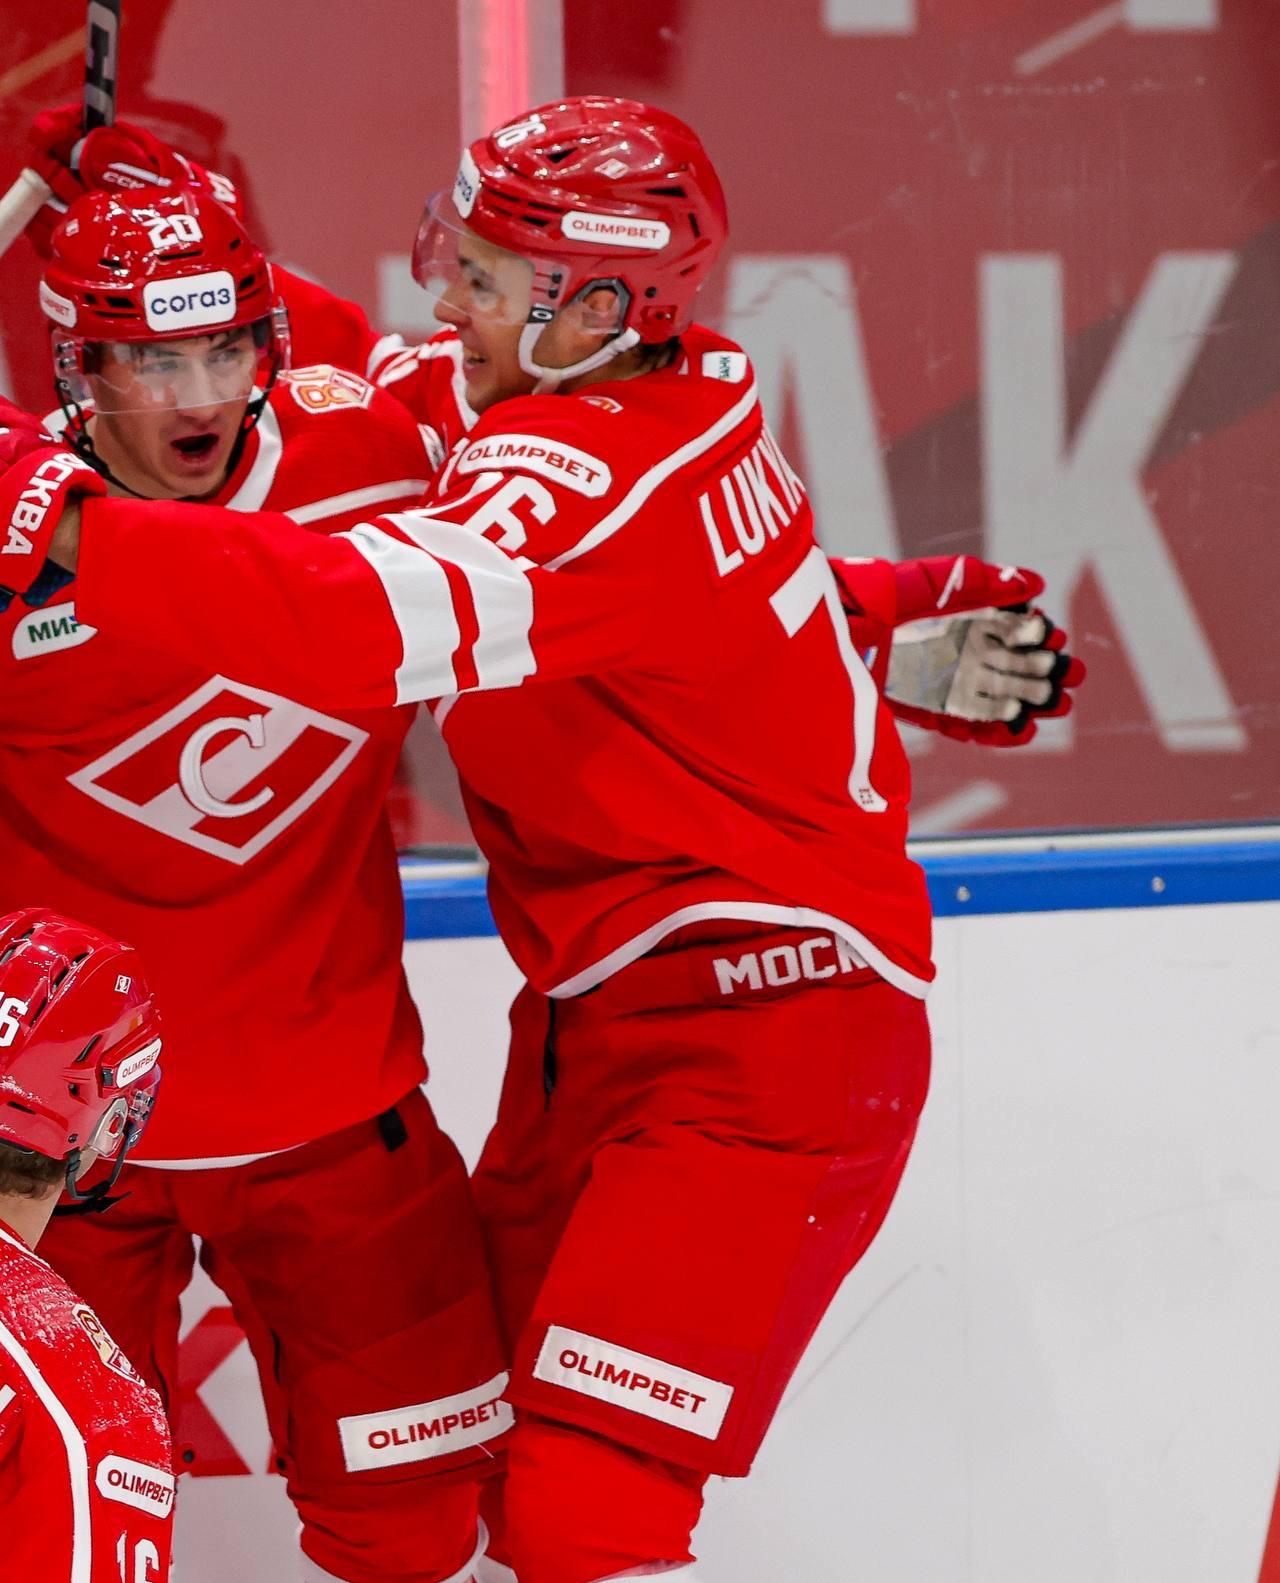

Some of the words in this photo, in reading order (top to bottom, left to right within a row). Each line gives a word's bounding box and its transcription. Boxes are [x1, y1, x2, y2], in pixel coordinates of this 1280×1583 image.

[143, 214, 203, 250] 20
[572, 220, 660, 240] OLIMPBET
[467, 444, 601, 485] OLIMPBET
[0, 452, 96, 555] ОСКВА
[122, 1050, 159, 1079] OLIMPBET
[559, 1348, 708, 1414] OLIMPBET
[367, 1399, 502, 1450] OLIMPBET
[107, 1469, 174, 1506] OLIMPBET
